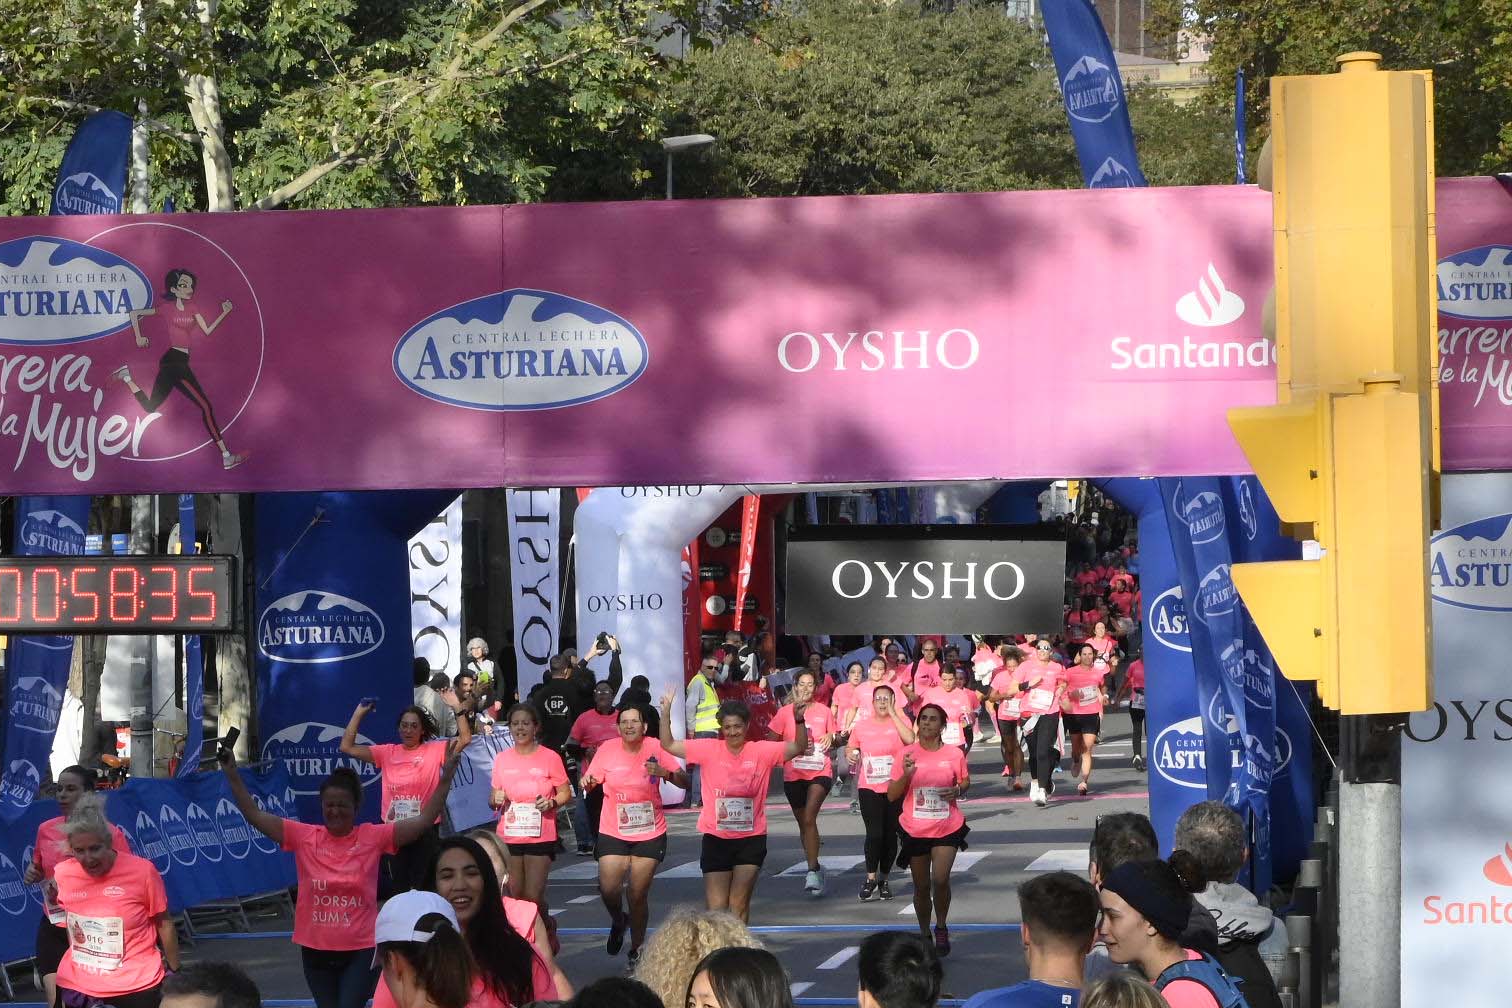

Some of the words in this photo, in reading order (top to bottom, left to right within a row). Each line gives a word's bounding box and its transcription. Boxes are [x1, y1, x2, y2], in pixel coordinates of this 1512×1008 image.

[57, 271, 128, 284] LECHERA
[451, 330, 532, 346] CENTRAL
[538, 329, 620, 343] LECHERA
[413, 336, 629, 381] ASTURIANA
[777, 329, 980, 374] OYSHO
[1111, 335, 1278, 370] Santand
[13, 386, 164, 482] Mujer
[28, 532, 85, 555] STURIANA
[1458, 549, 1512, 559] CENTR
[512, 488, 554, 666] OYSH
[832, 559, 1026, 601] OYSHO
[587, 593, 664, 613] OYSHO
[275, 614, 318, 624] CENTRAL
[321, 614, 371, 623] LECHERA
[262, 619, 375, 646] ASTURIANA
[550, 700, 565, 710] BP
[1403, 698, 1512, 743] OYS
[281, 746, 314, 756] ENTRAL
[312, 880, 327, 891] TU
[312, 911, 350, 923] SUMA
[86, 934, 104, 945] 016
